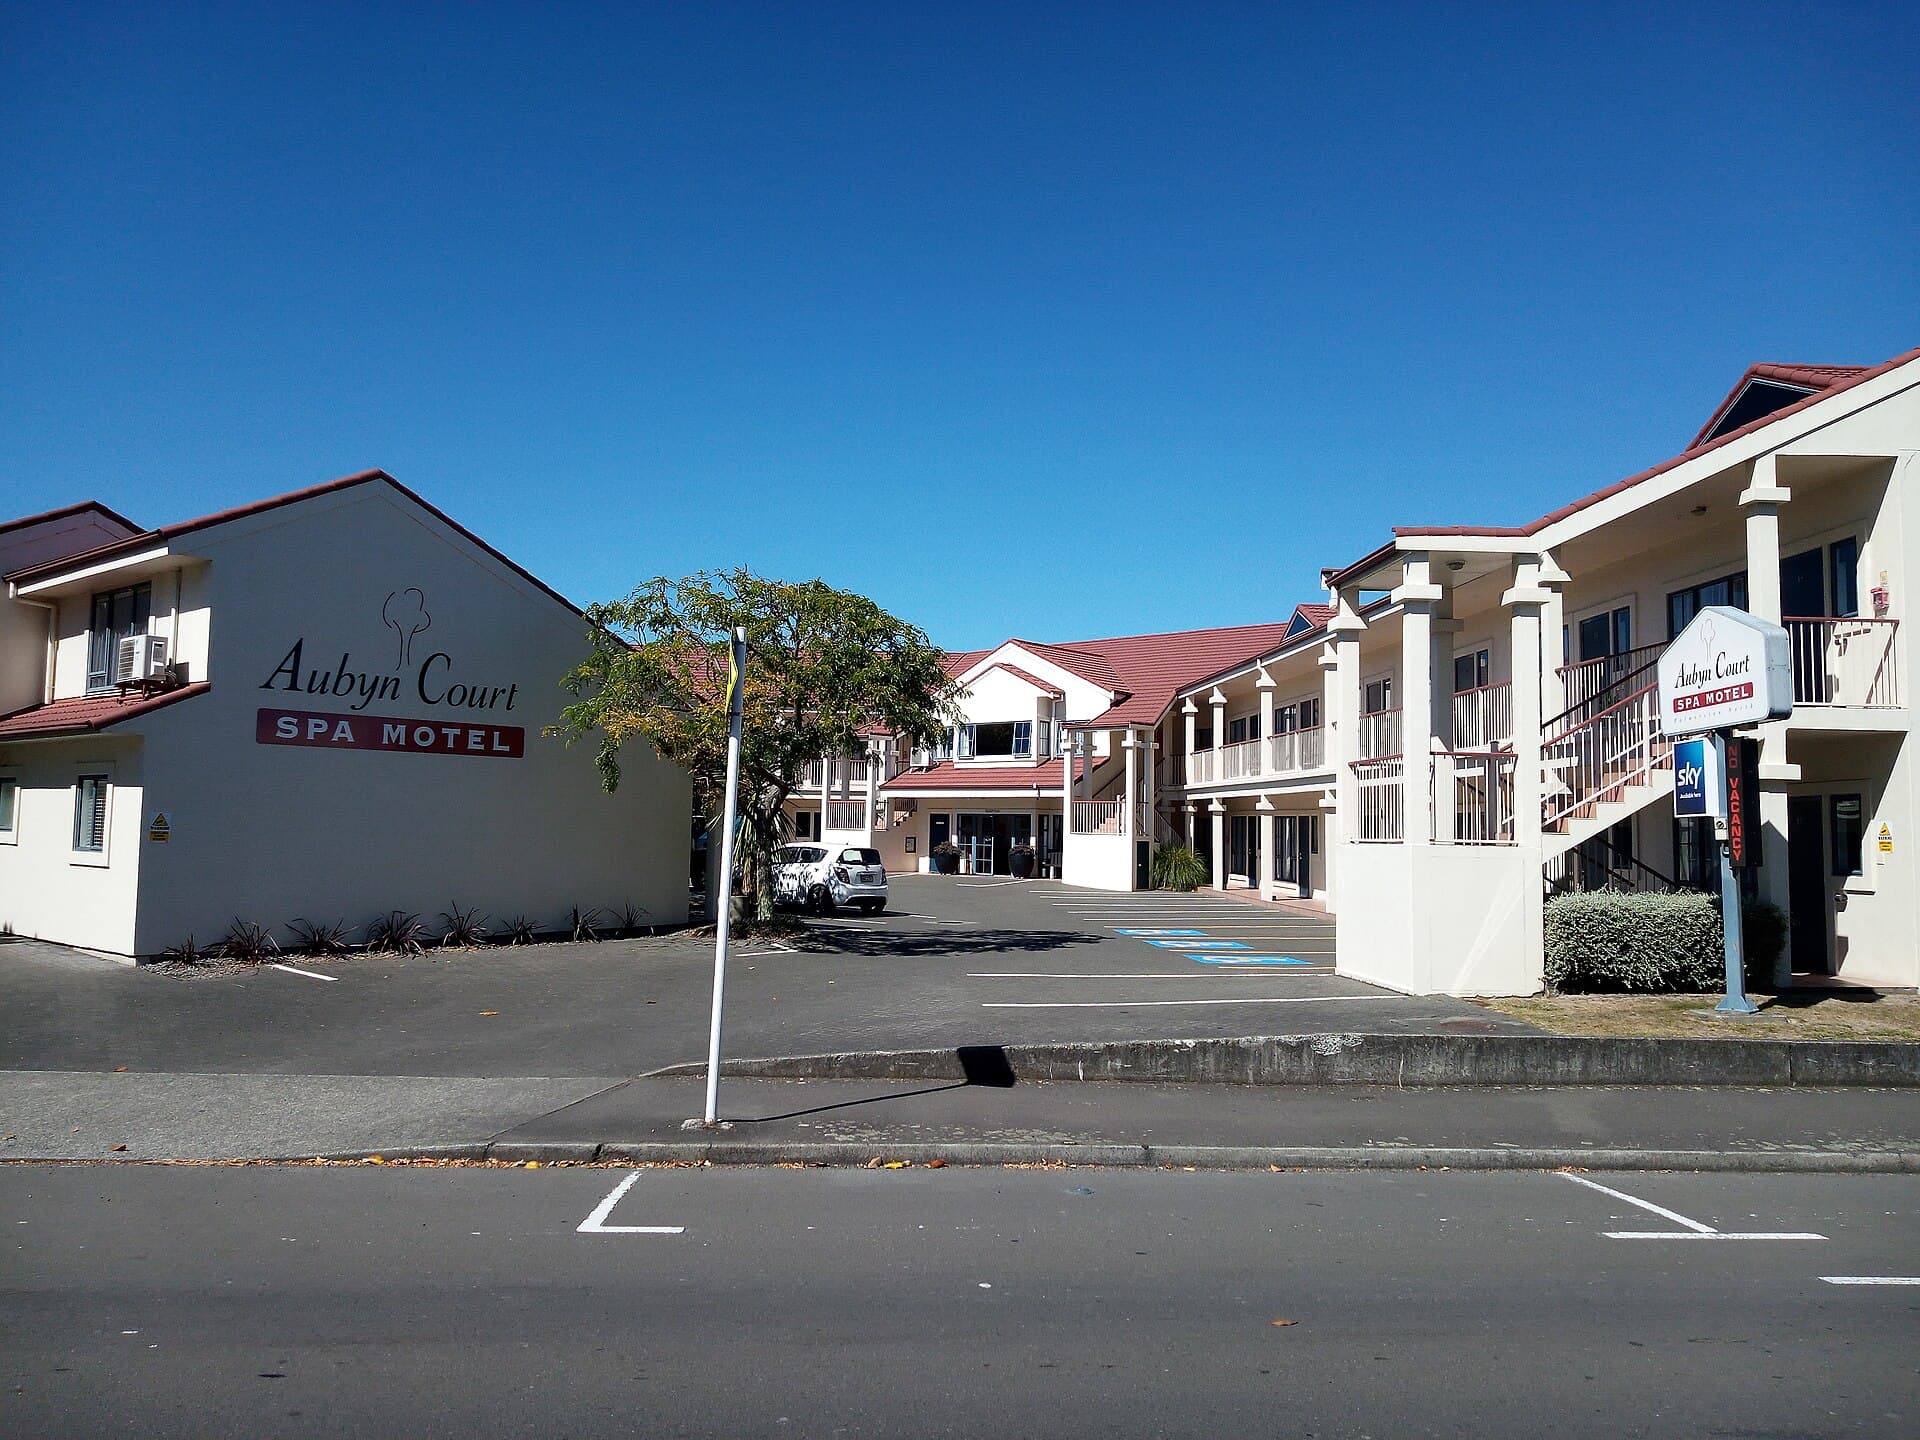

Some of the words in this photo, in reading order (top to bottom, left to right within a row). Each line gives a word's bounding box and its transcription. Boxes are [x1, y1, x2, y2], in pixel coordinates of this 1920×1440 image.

[258, 637, 401, 711] Aubyn
[418, 652, 519, 711] Court
[1674, 662, 1712, 690] Aubyn
[1715, 651, 1750, 680] Court
[1677, 695, 1700, 712] SPA
[1706, 687, 1749, 705] MOTEL
[275, 716, 355, 743] SPA
[381, 723, 510, 752] MOTEL
[1727, 744, 1738, 768] NO
[1728, 777, 1743, 862] VACANCY
